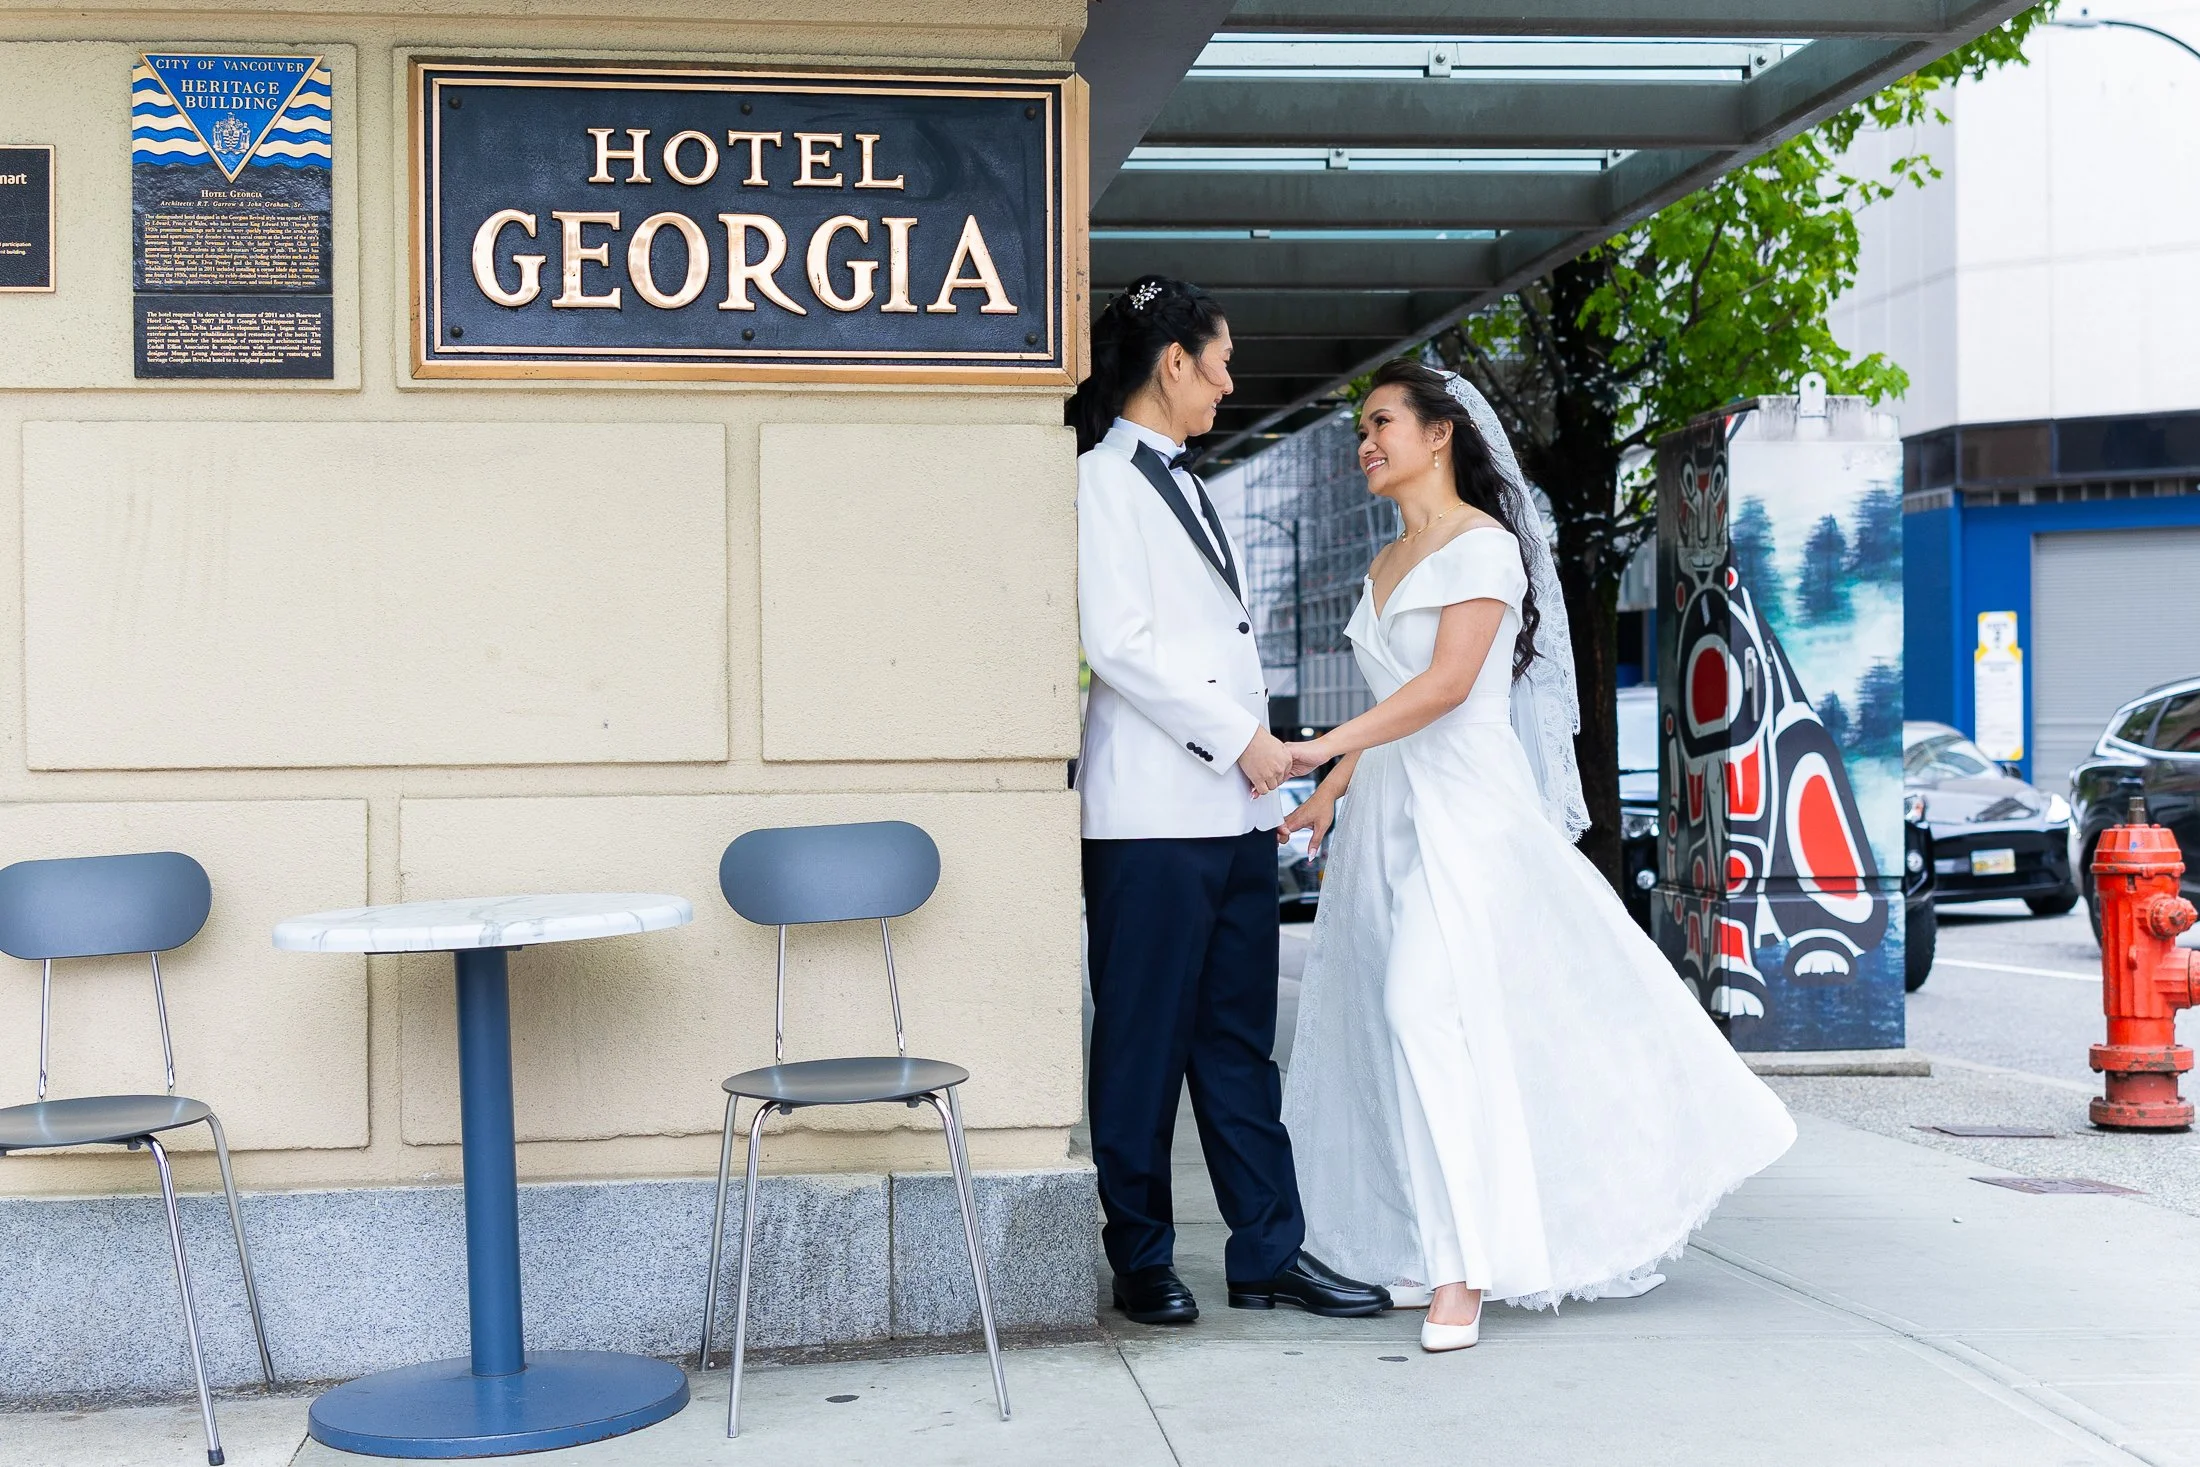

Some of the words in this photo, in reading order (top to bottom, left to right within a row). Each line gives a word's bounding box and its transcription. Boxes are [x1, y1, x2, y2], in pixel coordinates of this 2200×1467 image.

[156, 59, 190, 70] CITY
[198, 60, 215, 70] OF
[224, 61, 305, 73] VANCOUVER
[181, 79, 280, 94] HERITAGE
[185, 95, 278, 110] BUILDING
[587, 127, 904, 189] HOTEL
[471, 208, 1019, 315] GEORGIA
